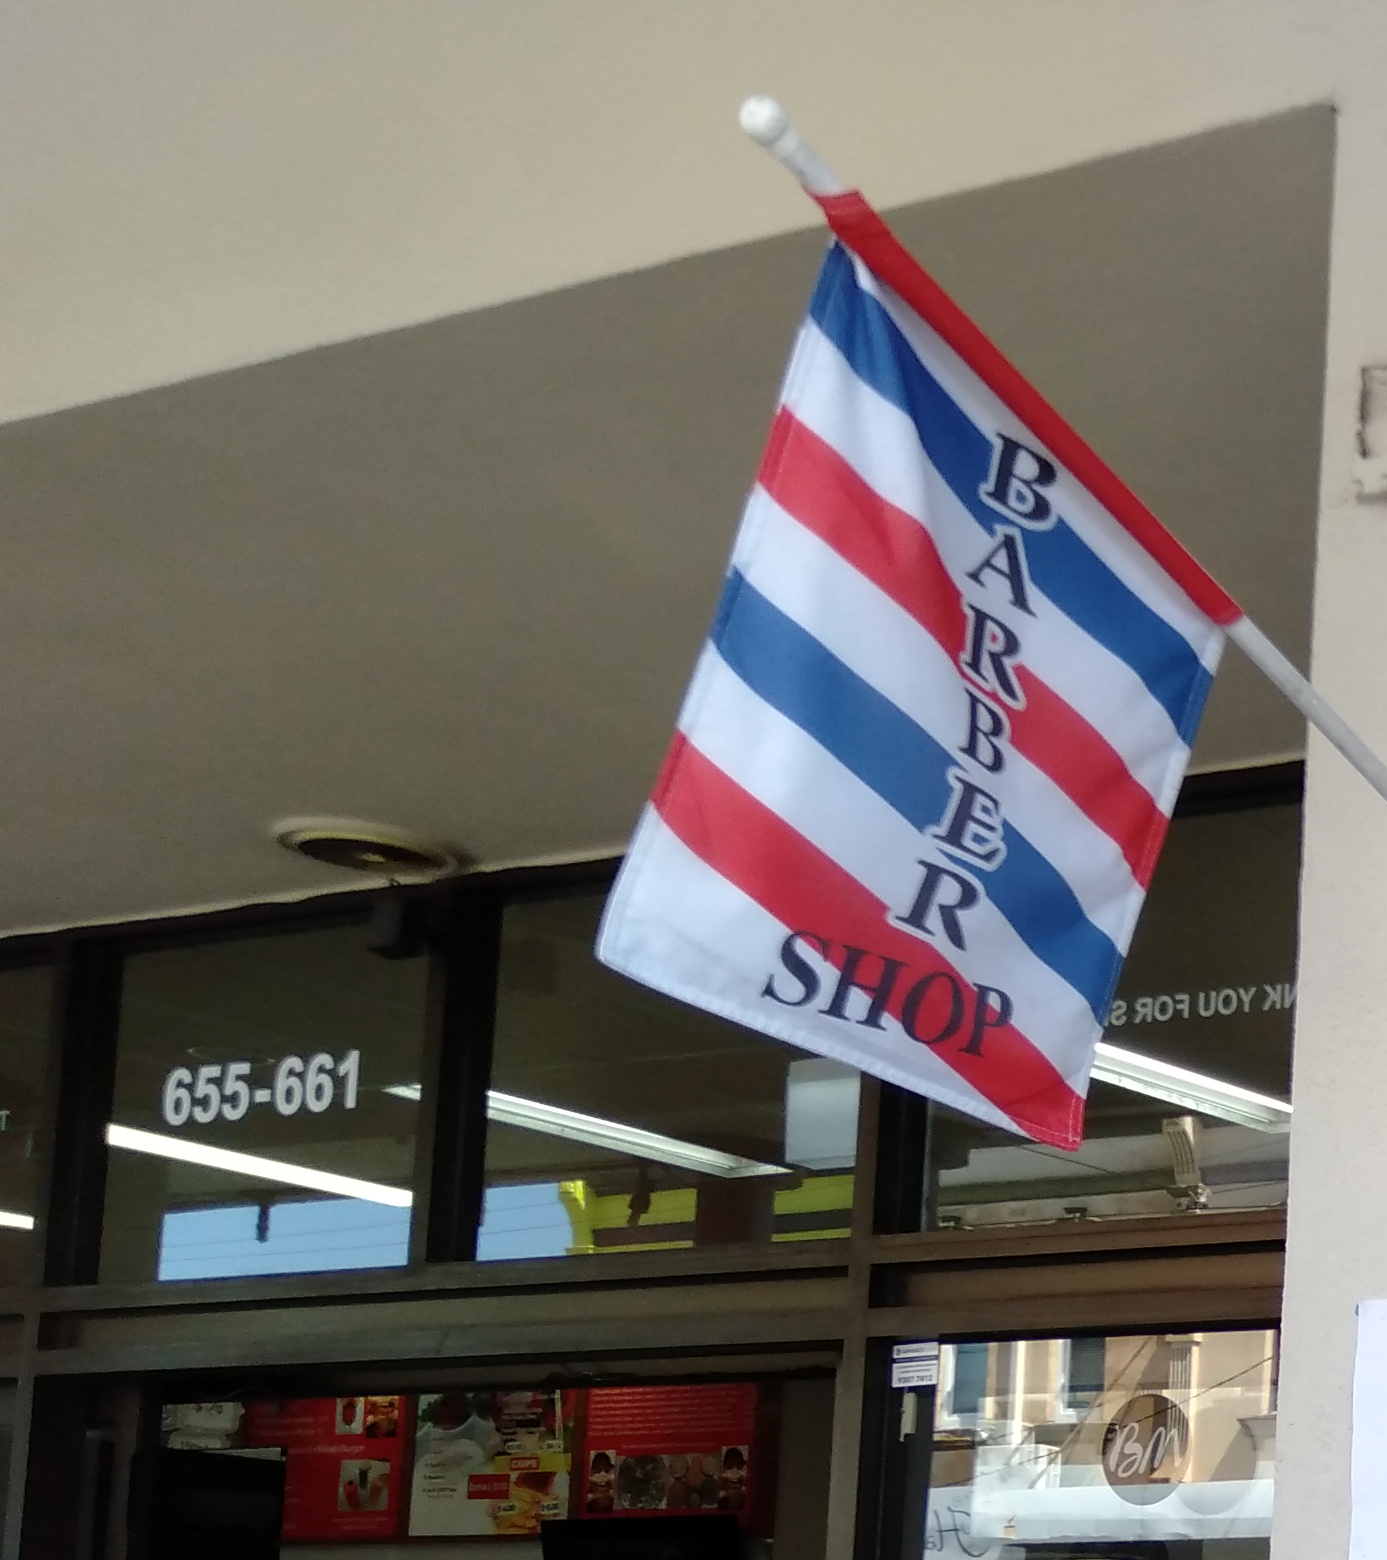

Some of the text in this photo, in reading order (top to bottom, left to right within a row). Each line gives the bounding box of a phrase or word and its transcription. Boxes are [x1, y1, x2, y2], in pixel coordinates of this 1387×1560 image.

[889, 432, 1059, 953] BARBER
[760, 929, 1014, 1059] SHOP
[161, 1049, 361, 1127] 655-661
